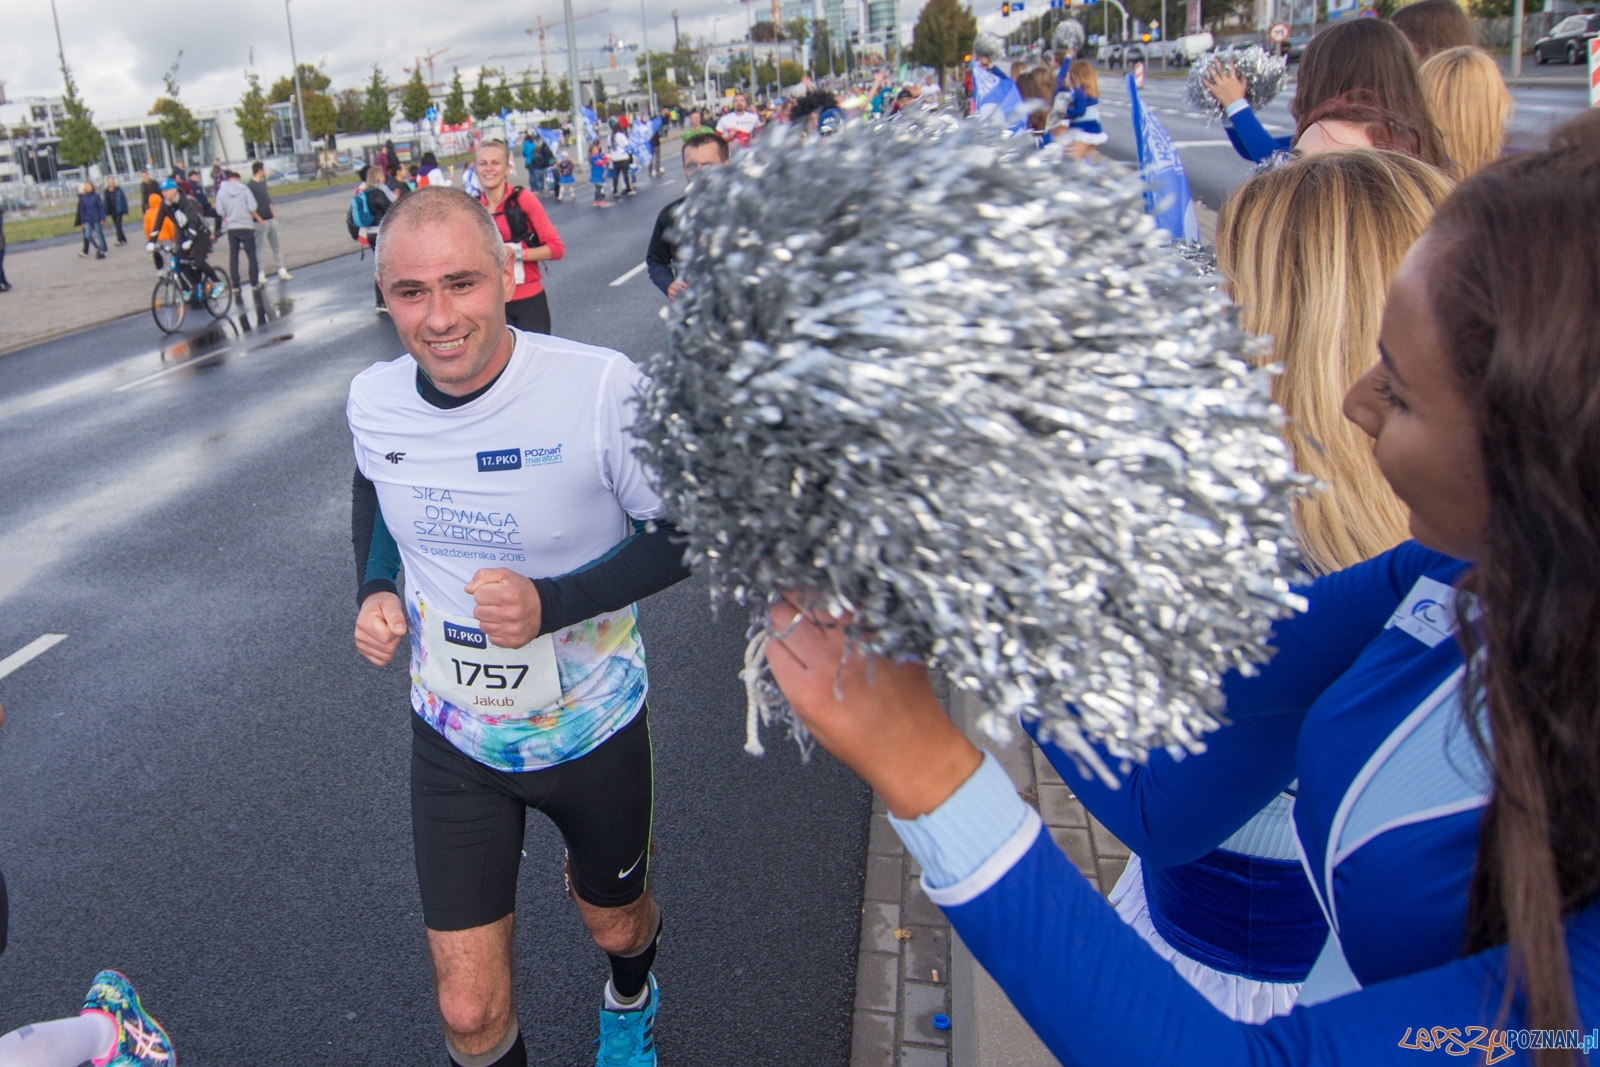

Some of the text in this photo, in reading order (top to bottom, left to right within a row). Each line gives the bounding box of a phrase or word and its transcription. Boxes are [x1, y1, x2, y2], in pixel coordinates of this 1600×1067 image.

[385, 451, 407, 465] 4F
[525, 454, 562, 465] maraton
[412, 486, 454, 504] SIŁA
[425, 505, 519, 527] ODWAGA
[413, 520, 522, 545] SZYBKOŚĆ
[420, 544, 526, 562] 9 października 2016
[451, 657, 529, 690] 1757
[472, 695, 514, 707] Jakub
